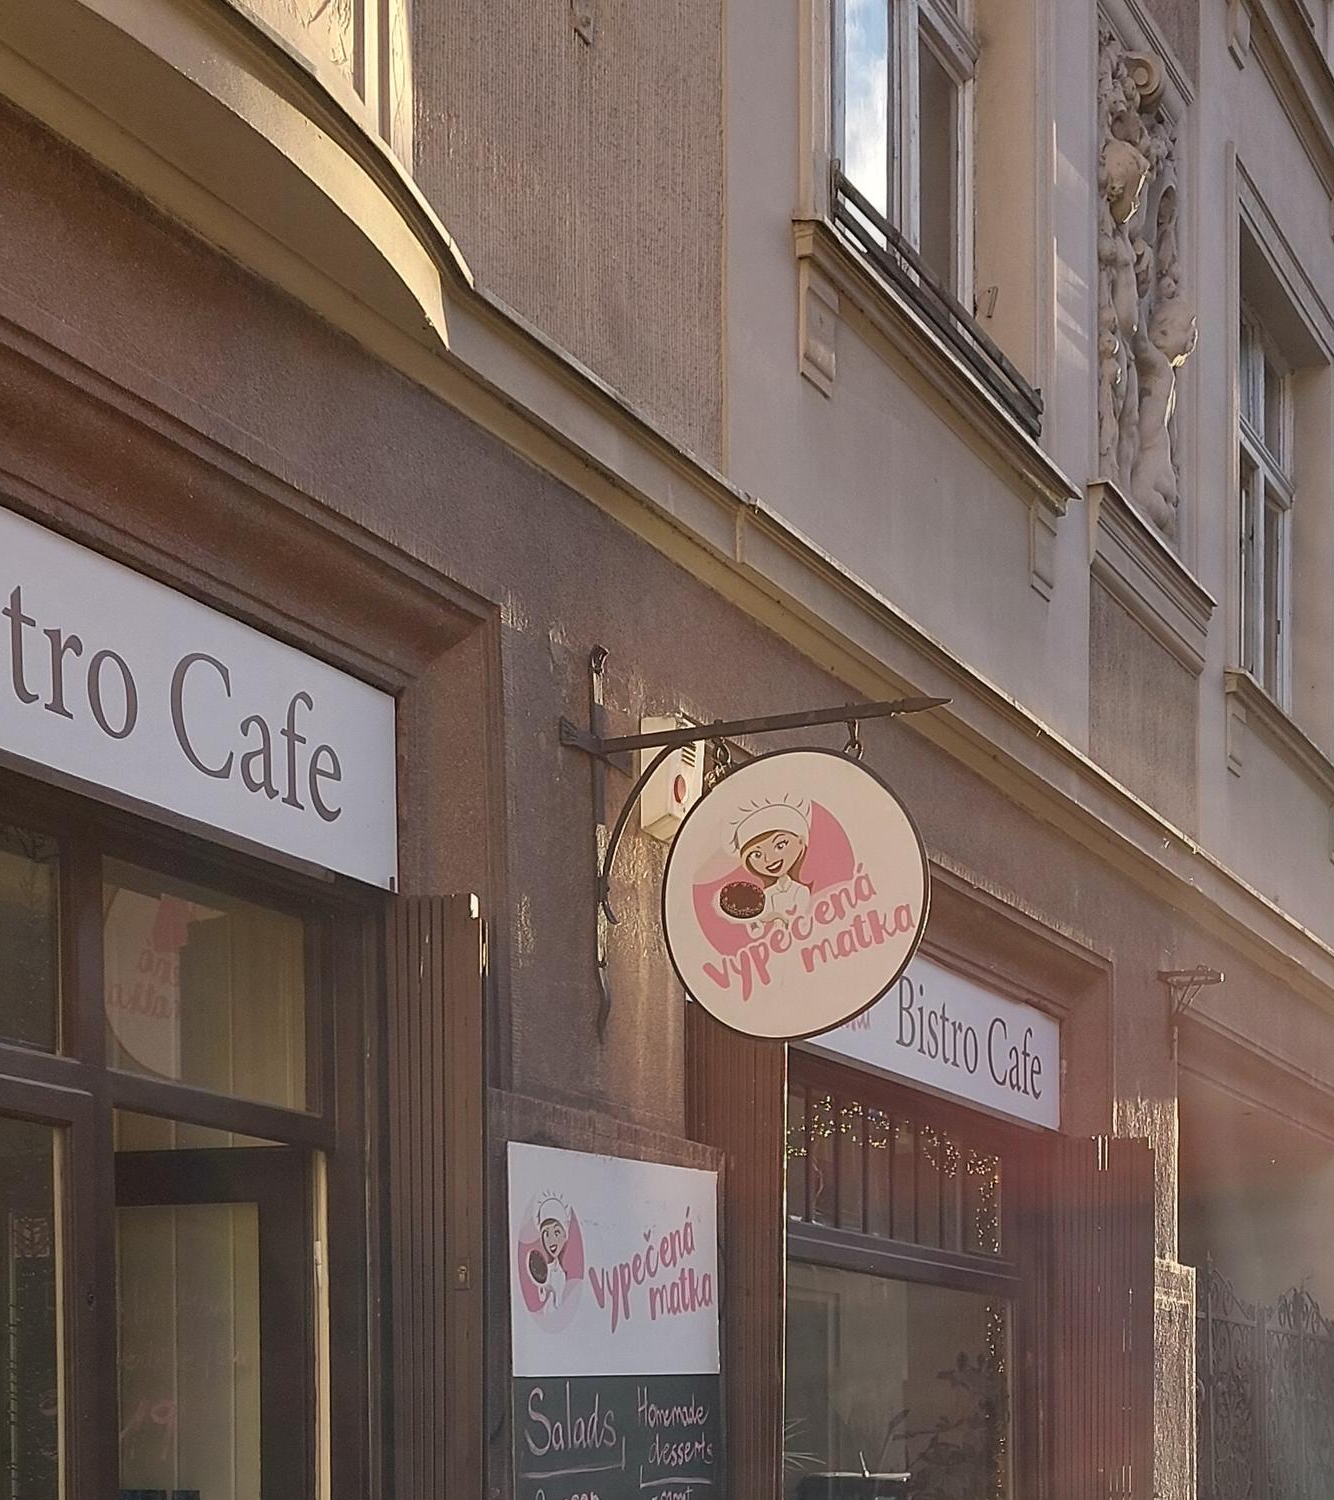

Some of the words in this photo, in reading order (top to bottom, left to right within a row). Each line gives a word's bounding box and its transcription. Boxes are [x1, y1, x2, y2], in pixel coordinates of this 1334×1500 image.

[170, 650, 343, 823] Cafe
[702, 863, 878, 1002] vypečená
[800, 901, 916, 973] matka
[895, 974, 979, 1075] Bistro
[986, 1016, 1043, 1101] Cafe
[588, 1205, 695, 1334] vypečená
[648, 1267, 713, 1321] matka
[523, 1381, 618, 1457] Salads
